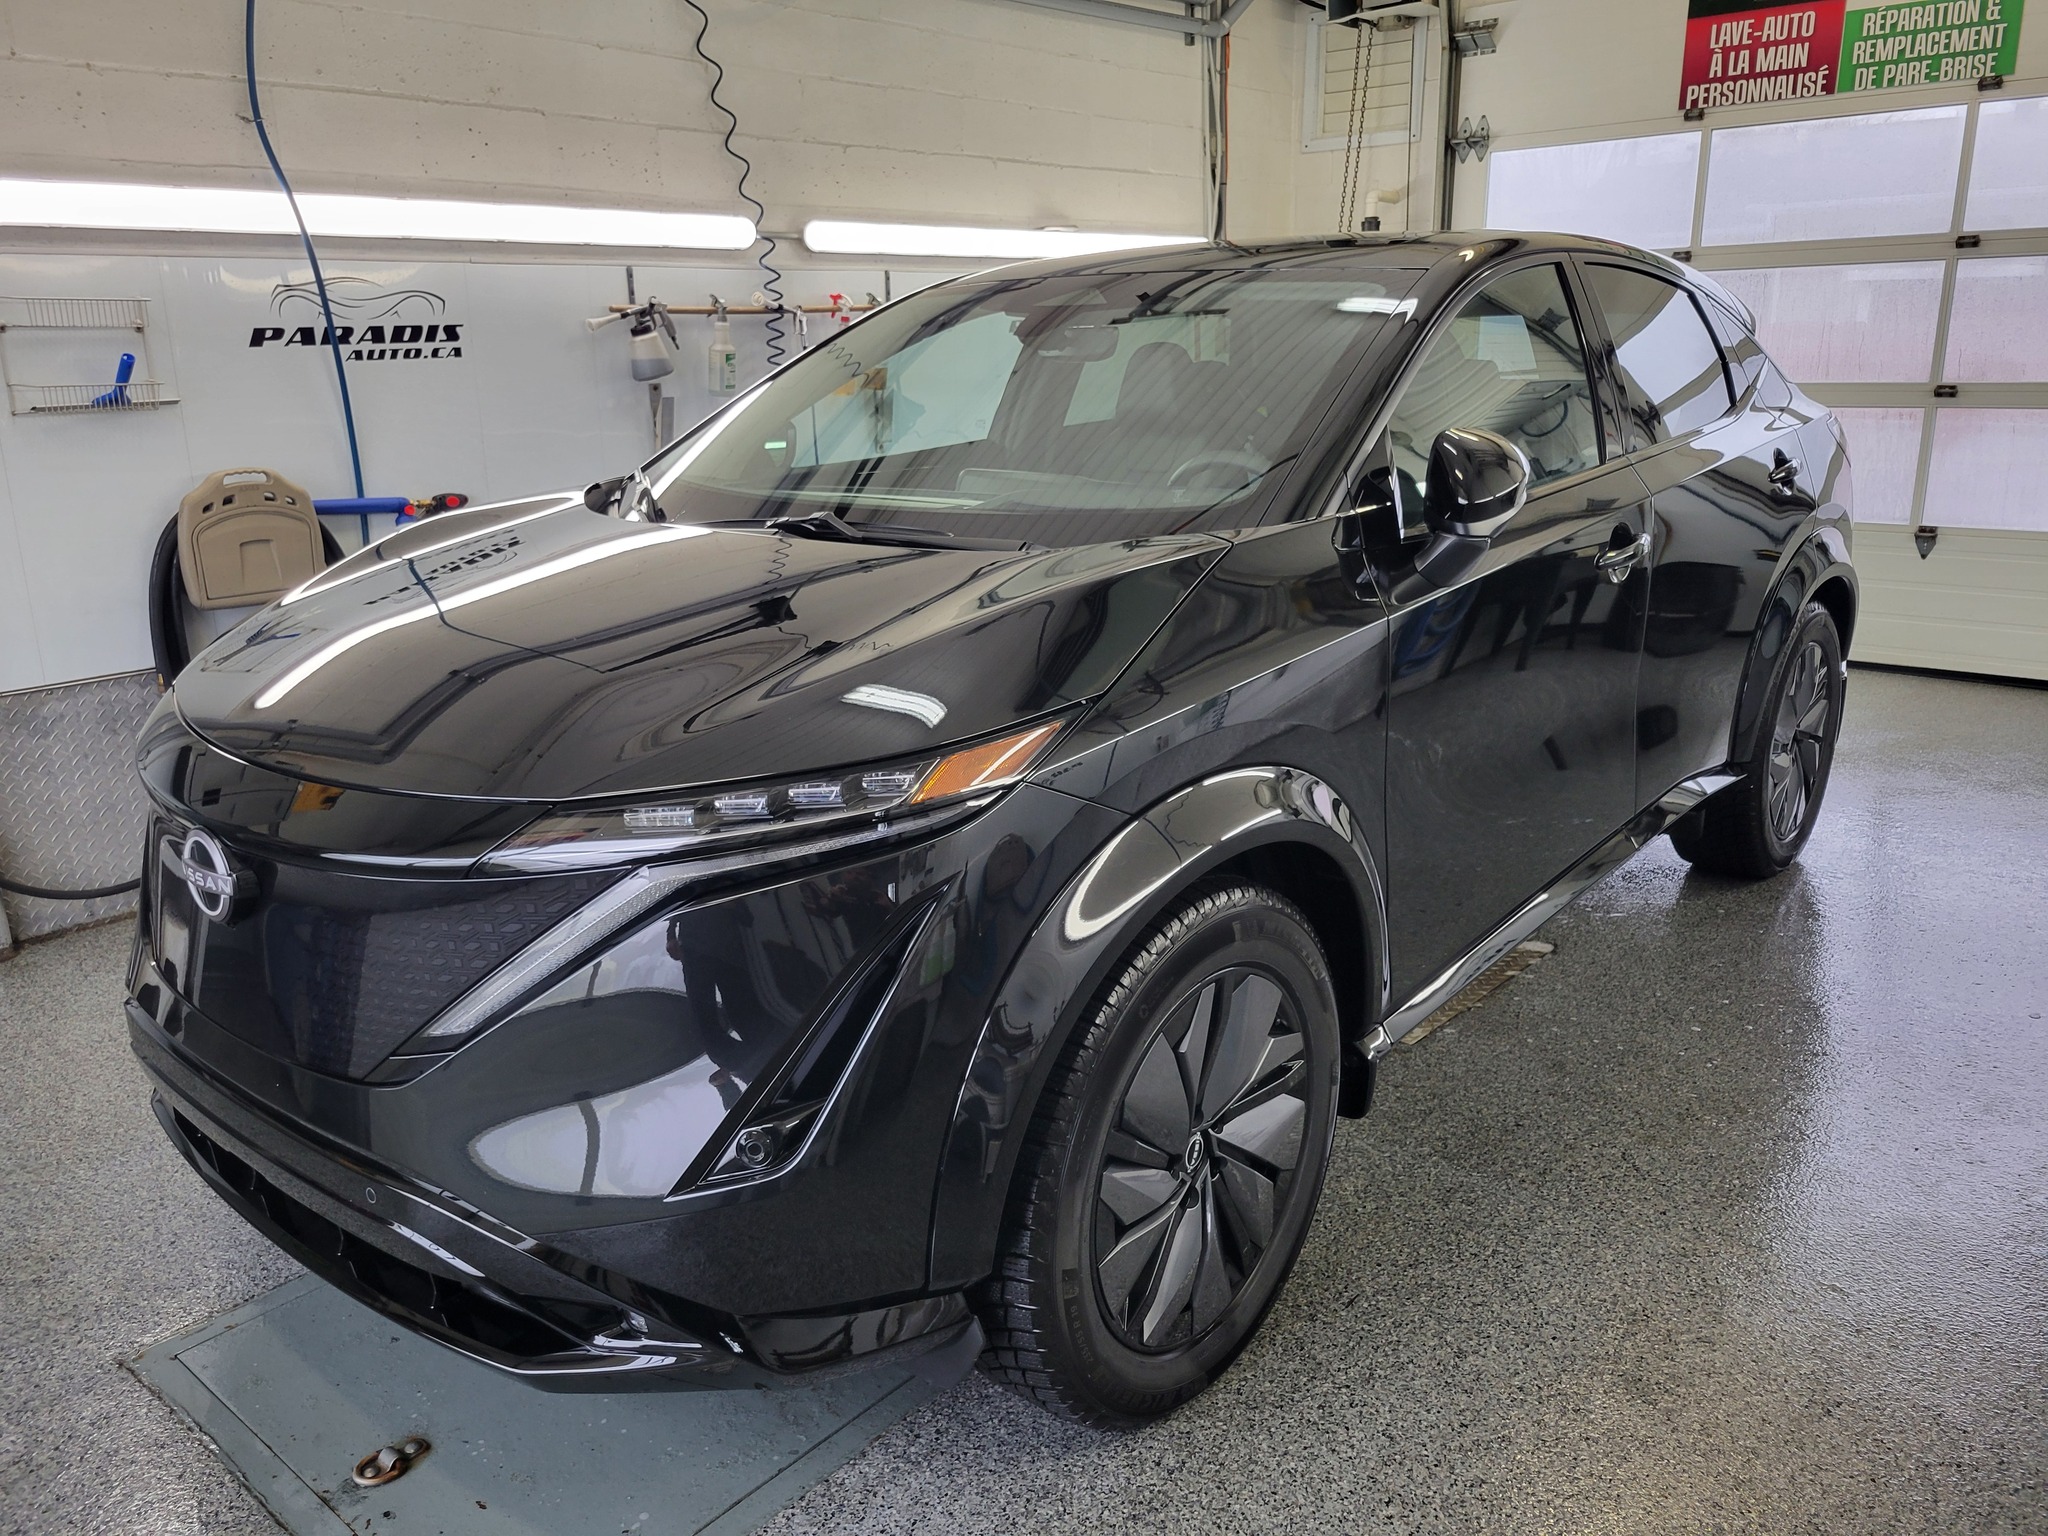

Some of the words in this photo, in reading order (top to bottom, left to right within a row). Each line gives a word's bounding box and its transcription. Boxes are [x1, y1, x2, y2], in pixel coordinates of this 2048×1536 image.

[1710, 11, 1816, 49] LAVE-AUTO
[1862, 0, 1980, 37] RÉPARATION
[1709, 48, 1723, 79] À
[1728, 49, 1750, 76] LA
[1755, 42, 1810, 73] MAIN
[1852, 23, 2008, 65] REMPLACEMENT
[1685, 64, 1829, 110] PERSONNALISÉ
[1854, 66, 1879, 91] DE
[1882, 52, 1999, 88] PARE-BRISE
[249, 324, 464, 348] PARADIS
[345, 346, 463, 362] AUTO.CA
